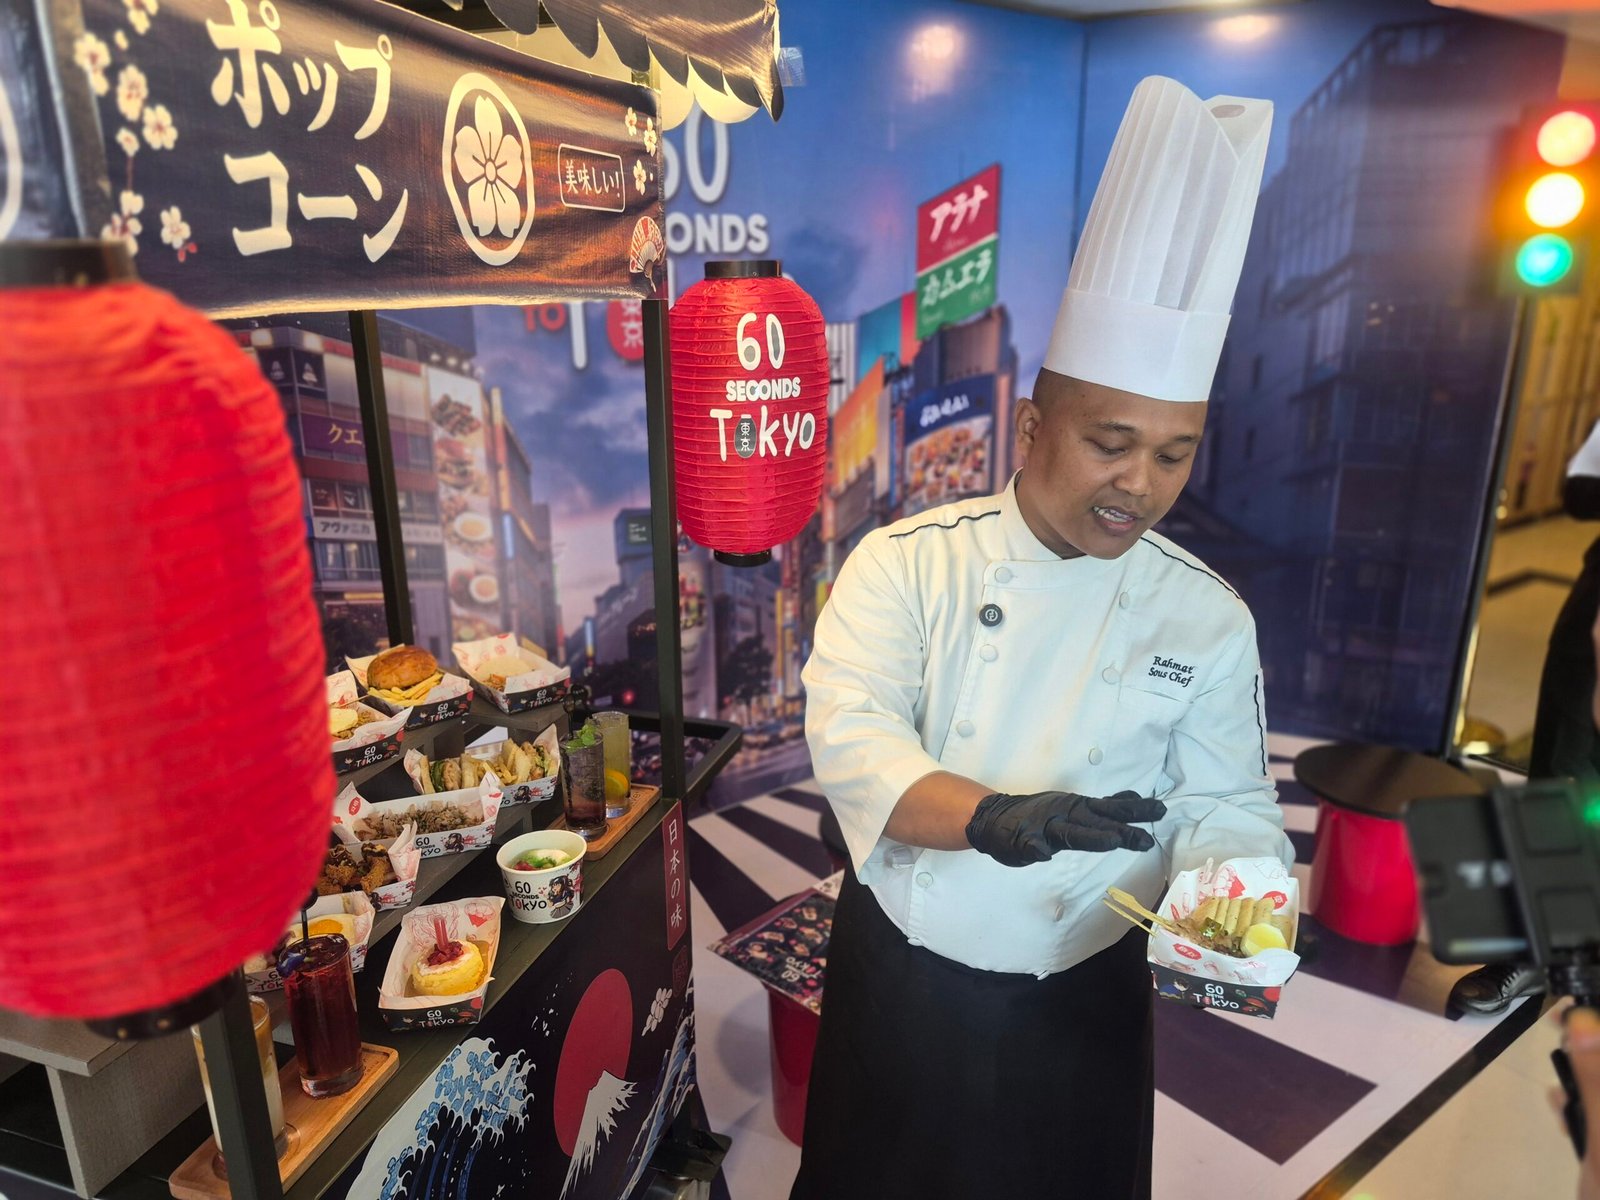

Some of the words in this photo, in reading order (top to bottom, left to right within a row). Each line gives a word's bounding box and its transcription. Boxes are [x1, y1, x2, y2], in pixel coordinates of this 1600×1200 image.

[206, 0, 393, 140] ポップ
[224, 150, 408, 263] コーン
[665, 211, 769, 254] ONDS
[736, 312, 785, 371] 60
[725, 376, 801, 402] SECONDS
[1152, 655, 1194, 674] Rahmat
[1148, 666, 1168, 678] Sous
[1168, 671, 1194, 688] Chef
[536, 688, 547, 698] 60
[437, 702, 449, 712] 60
[364, 745, 376, 756] 60
[415, 836, 430, 847] 60
[420, 847, 441, 857] kyo
[668, 818, 682, 929] 日本の味
[514, 880, 531, 894] 60
[1204, 983, 1224, 996] 60
[426, 1009, 442, 1018] 60
